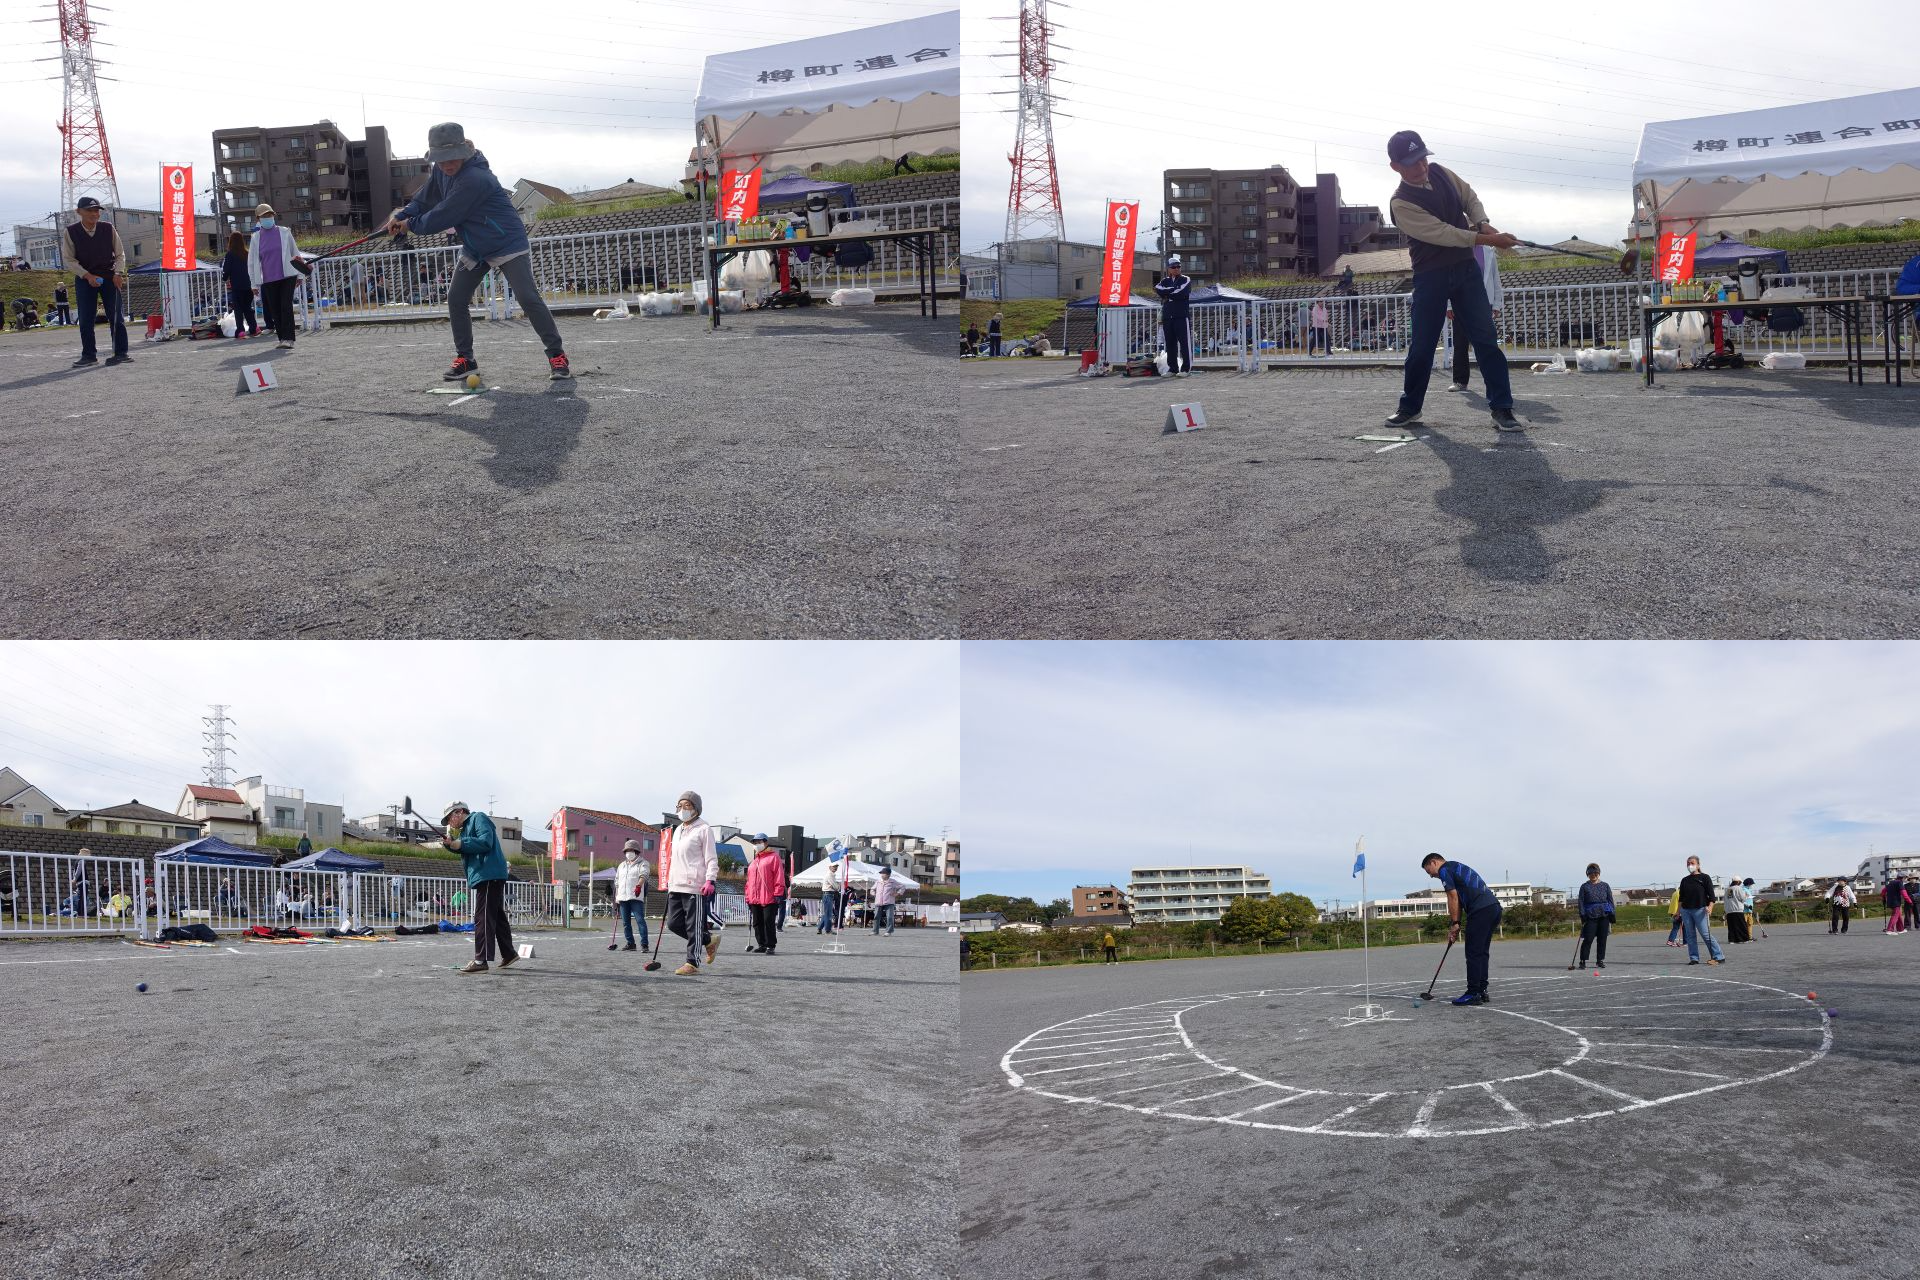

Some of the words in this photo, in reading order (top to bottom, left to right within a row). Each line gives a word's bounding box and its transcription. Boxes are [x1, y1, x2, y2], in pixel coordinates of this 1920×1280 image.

[756, 43, 960, 85] 樽町連合
[725, 171, 752, 219] 町内会
[172, 191, 187, 269] 樽町連合町内会
[1109, 227, 1128, 304] 樽町連合町内会
[1662, 233, 1688, 281] 町内会
[252, 368, 269, 388] 1
[1181, 407, 1198, 428] 1
